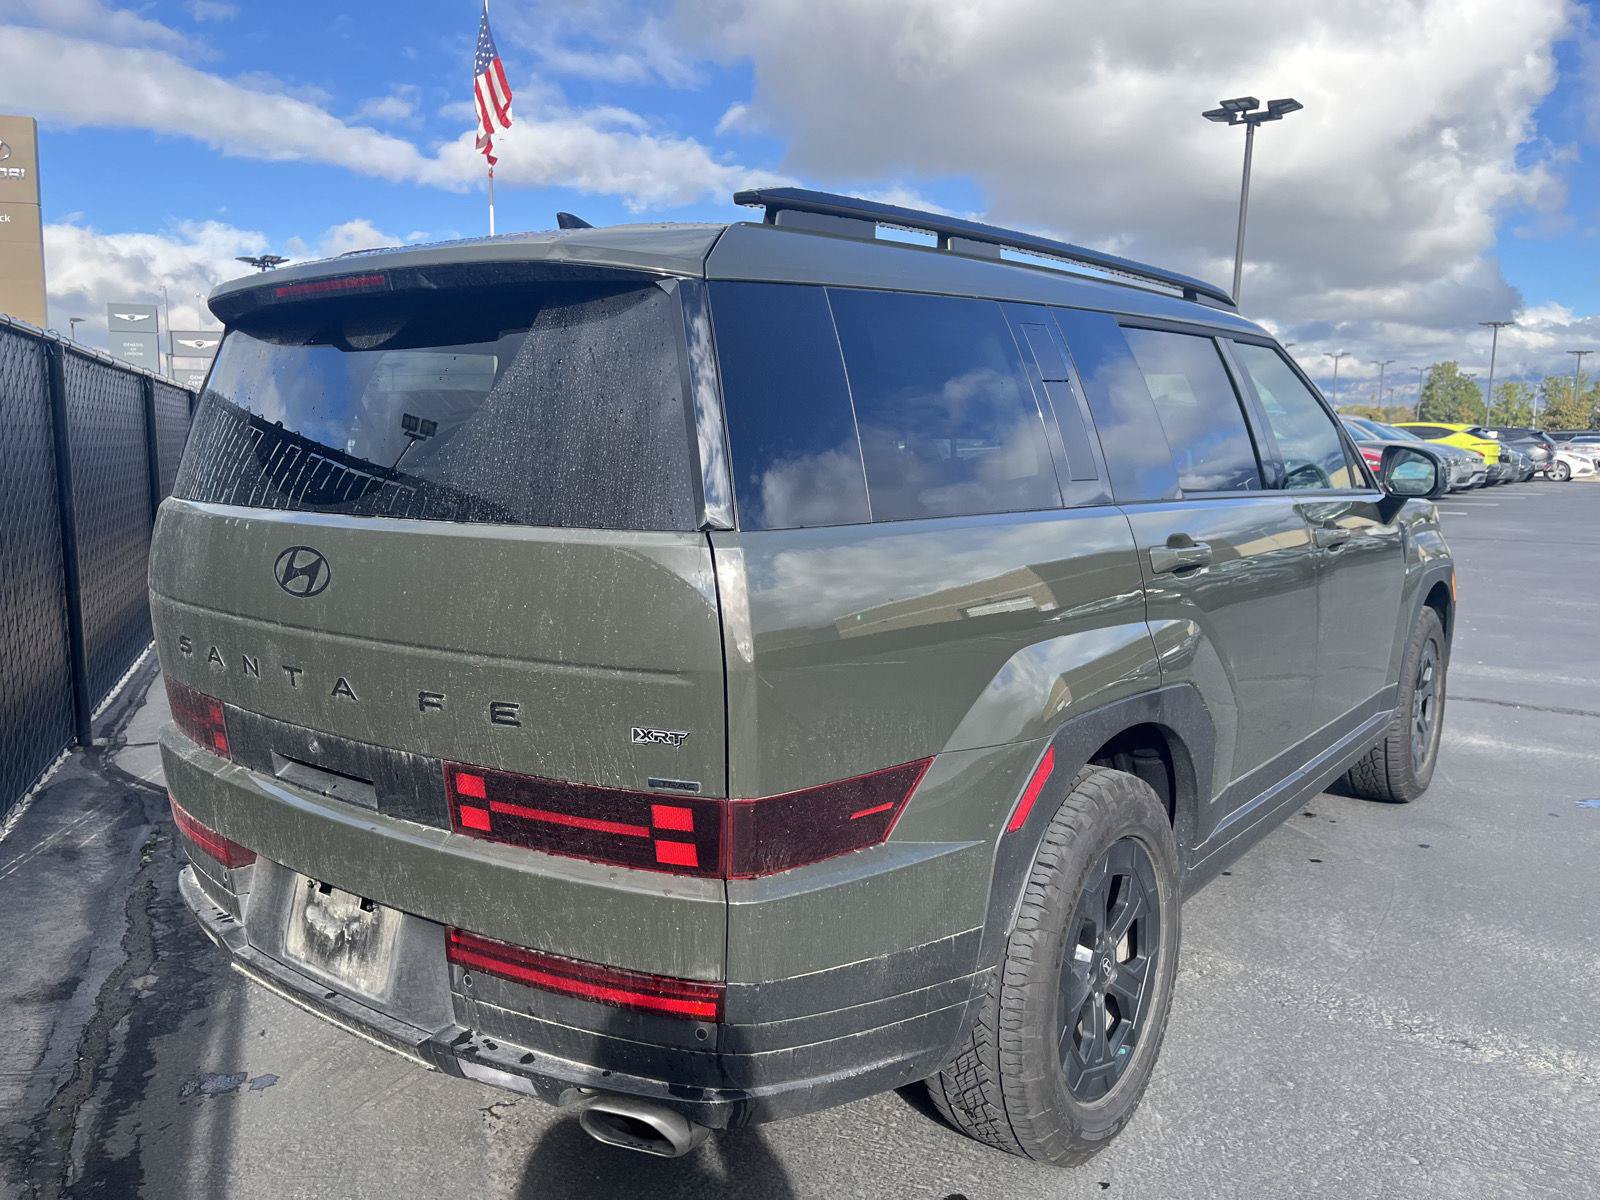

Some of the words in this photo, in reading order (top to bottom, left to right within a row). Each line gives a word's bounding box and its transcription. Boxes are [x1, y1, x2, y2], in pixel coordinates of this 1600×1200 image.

[179, 635, 360, 702] SANTA
[418, 690, 522, 728] FE
[631, 727, 691, 747] XRT
